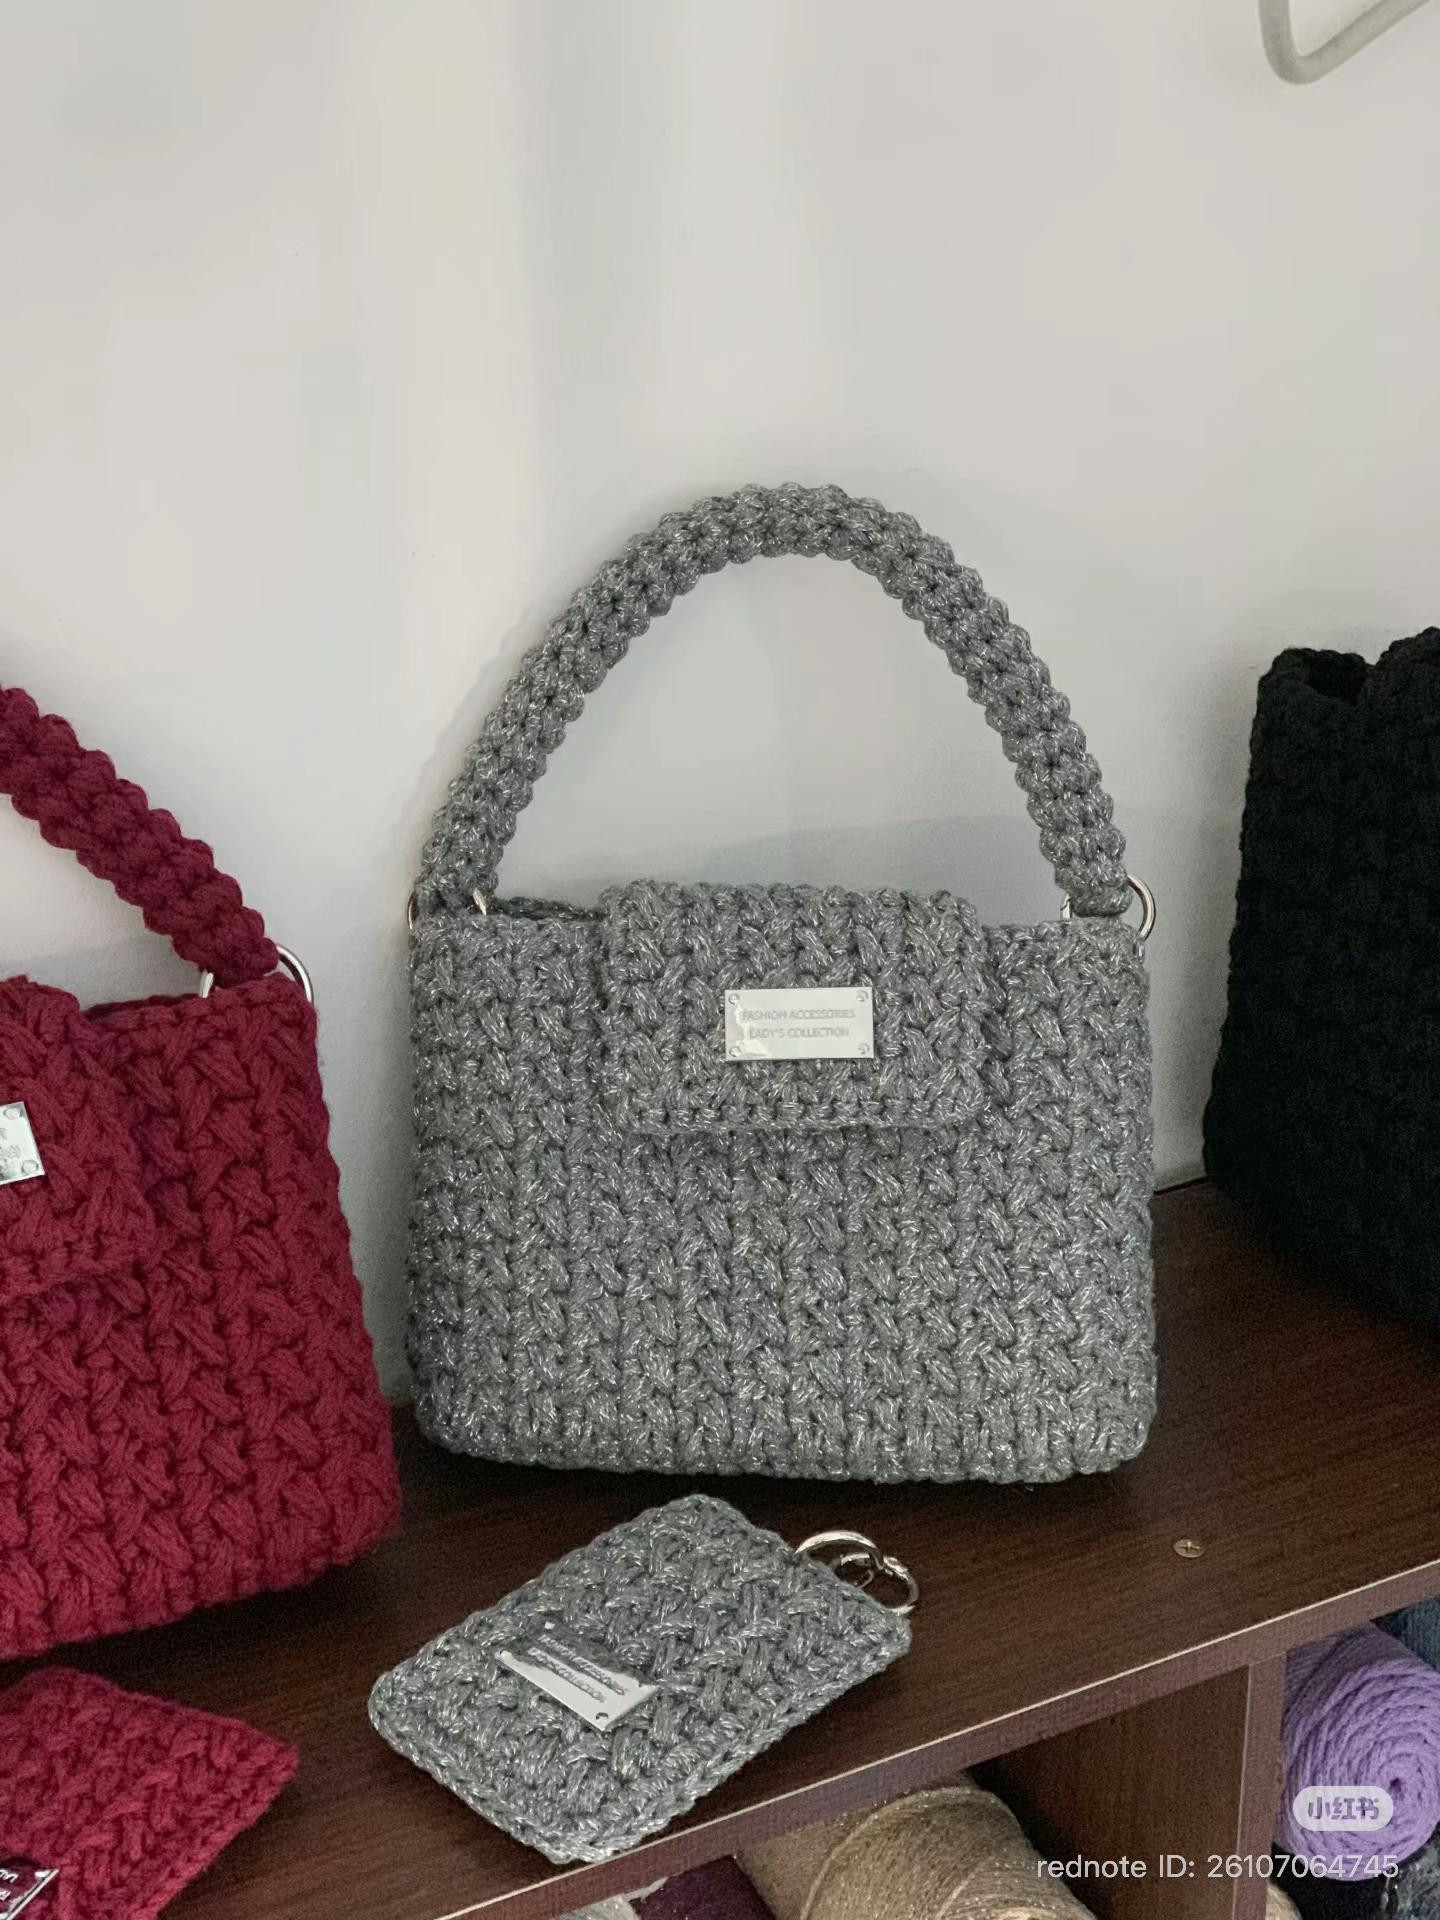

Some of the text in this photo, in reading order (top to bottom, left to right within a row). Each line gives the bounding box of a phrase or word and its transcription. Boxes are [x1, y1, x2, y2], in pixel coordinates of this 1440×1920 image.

[742, 1007, 856, 1020] FASHION ACCESSORIES
[748, 1026, 850, 1039] LADY'S COLLECTION
